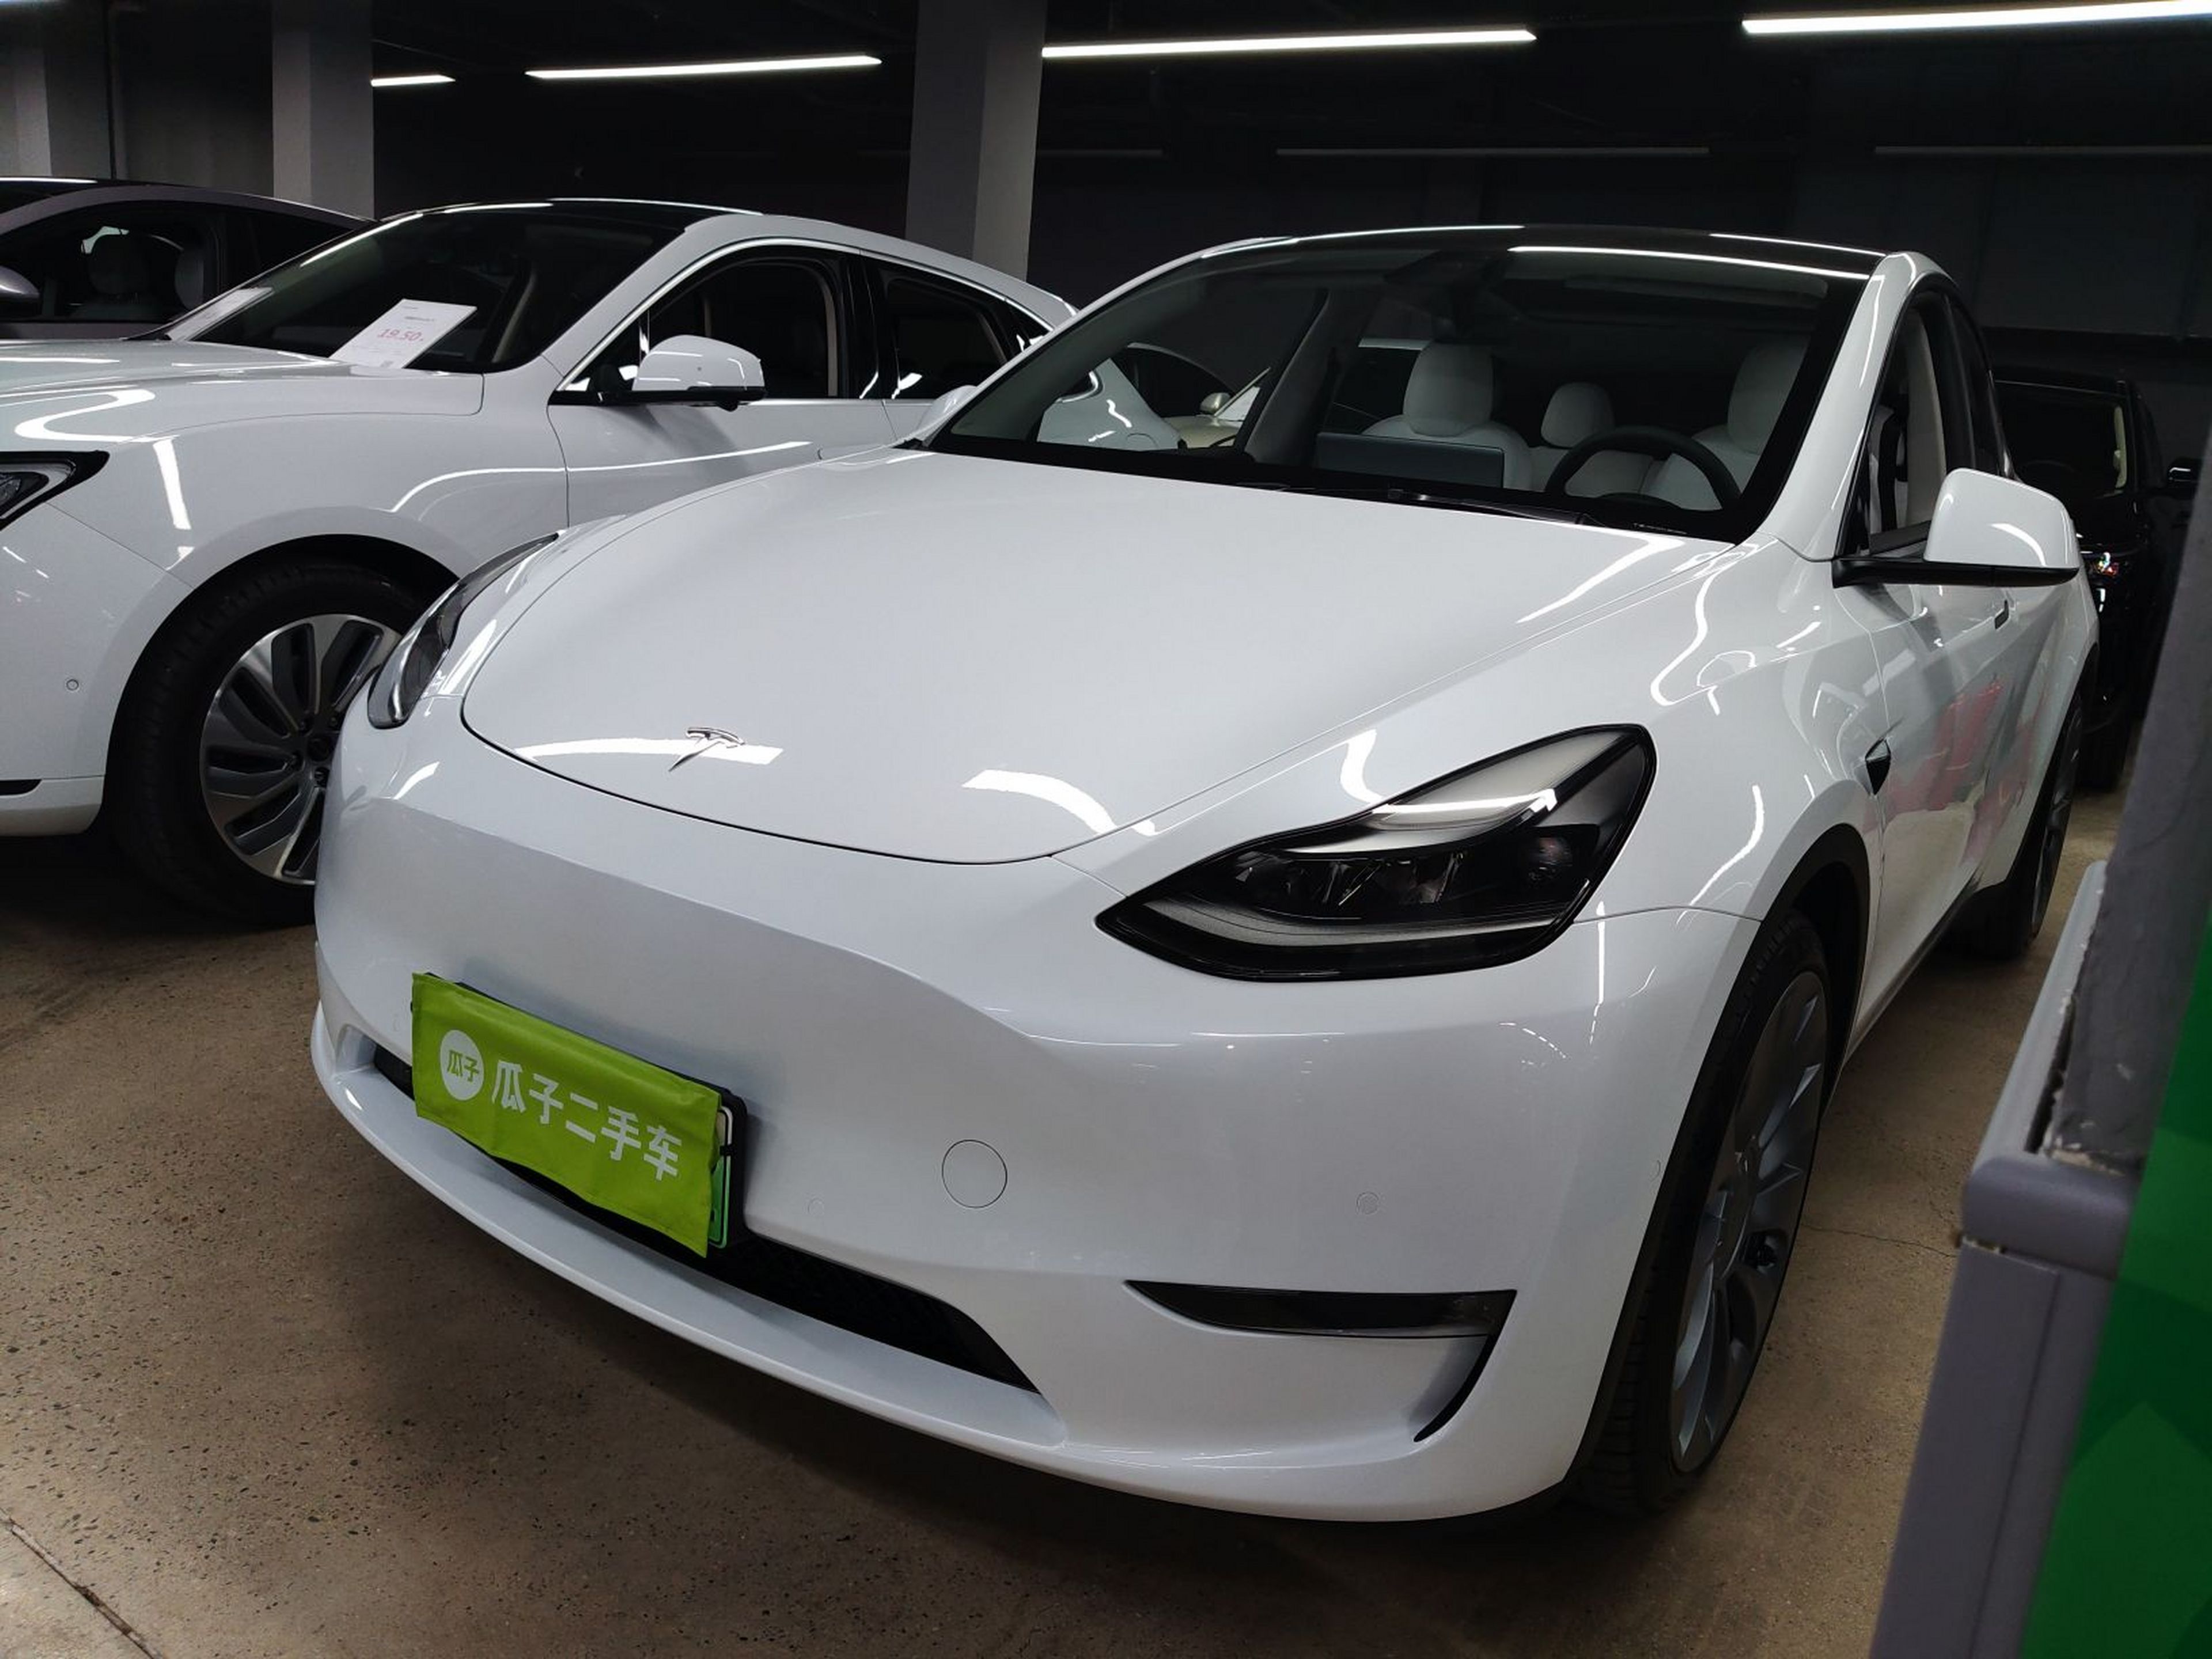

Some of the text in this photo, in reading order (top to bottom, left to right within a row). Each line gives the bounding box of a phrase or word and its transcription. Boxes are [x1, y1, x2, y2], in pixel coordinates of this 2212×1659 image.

[447, 1050, 479, 1082] 瓜子
[491, 1060, 682, 1181] 瓜子二手车
